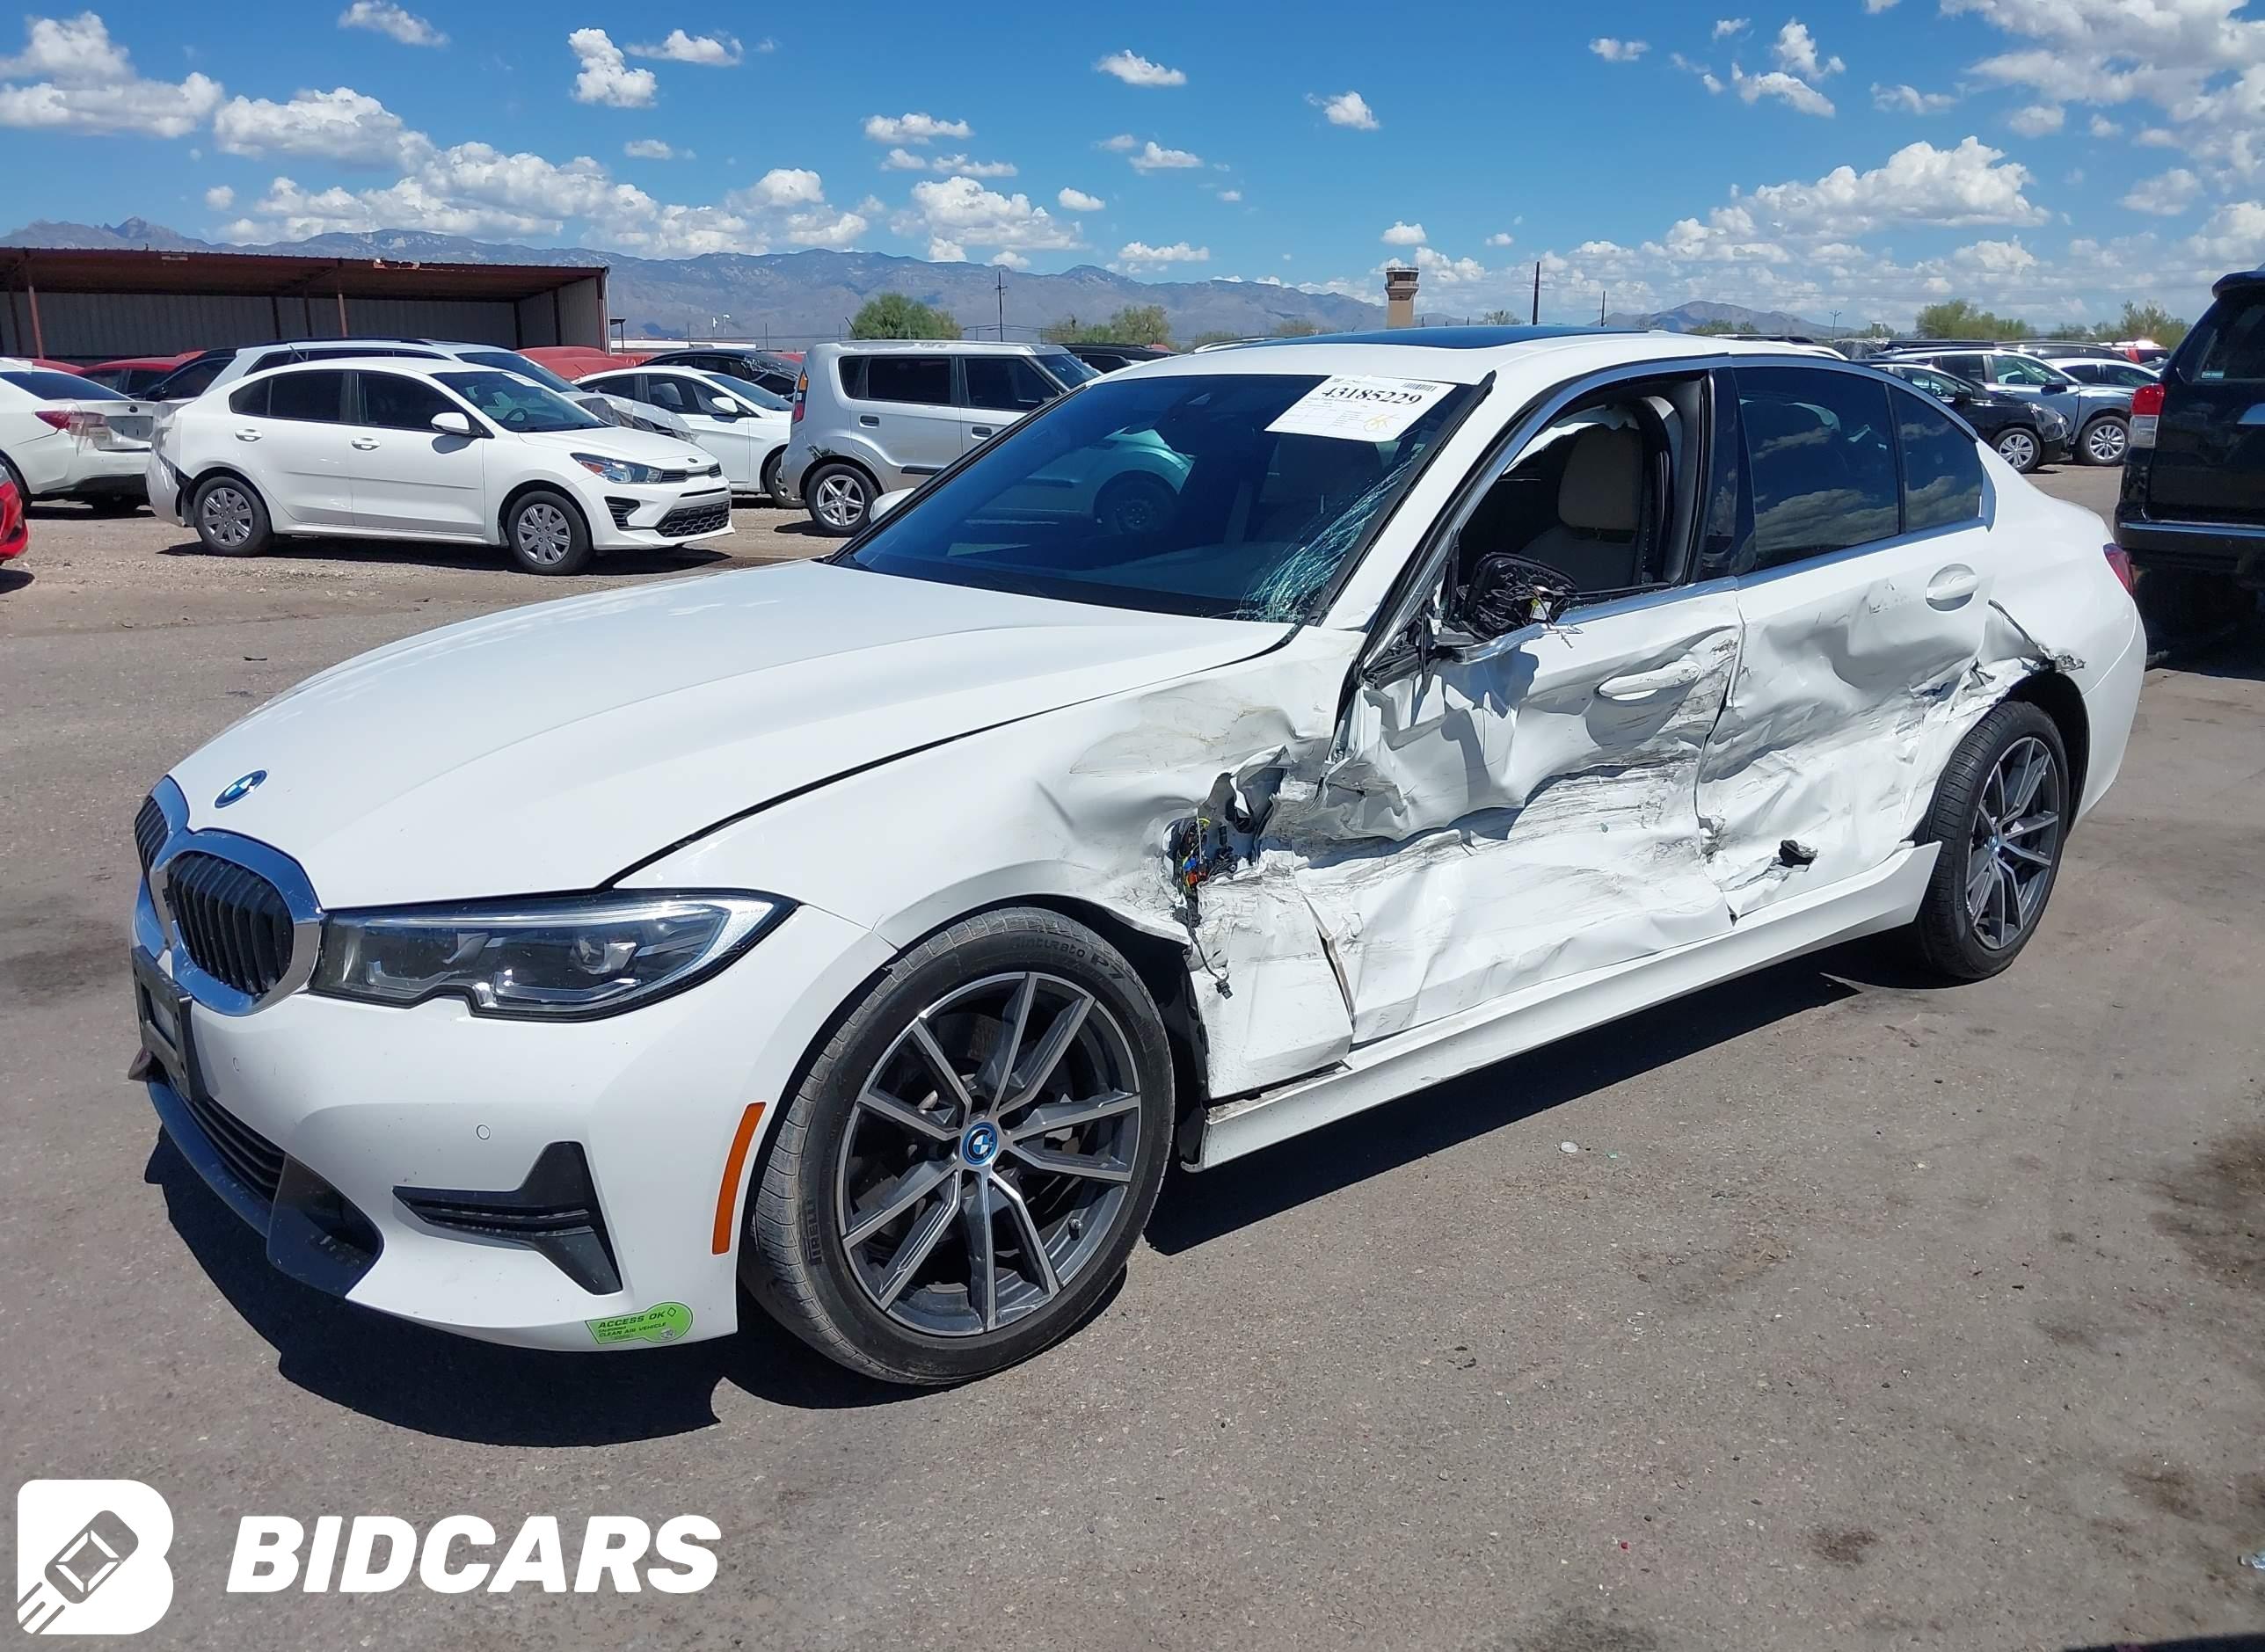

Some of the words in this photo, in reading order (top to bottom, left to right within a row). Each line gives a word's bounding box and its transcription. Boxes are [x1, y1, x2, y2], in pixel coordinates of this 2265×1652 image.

[1321, 387, 1424, 405] 43185229
[598, 1315, 645, 1328] ACCESS
[648, 1310, 666, 1321] OK
[638, 1321, 666, 1331] VEHICLE
